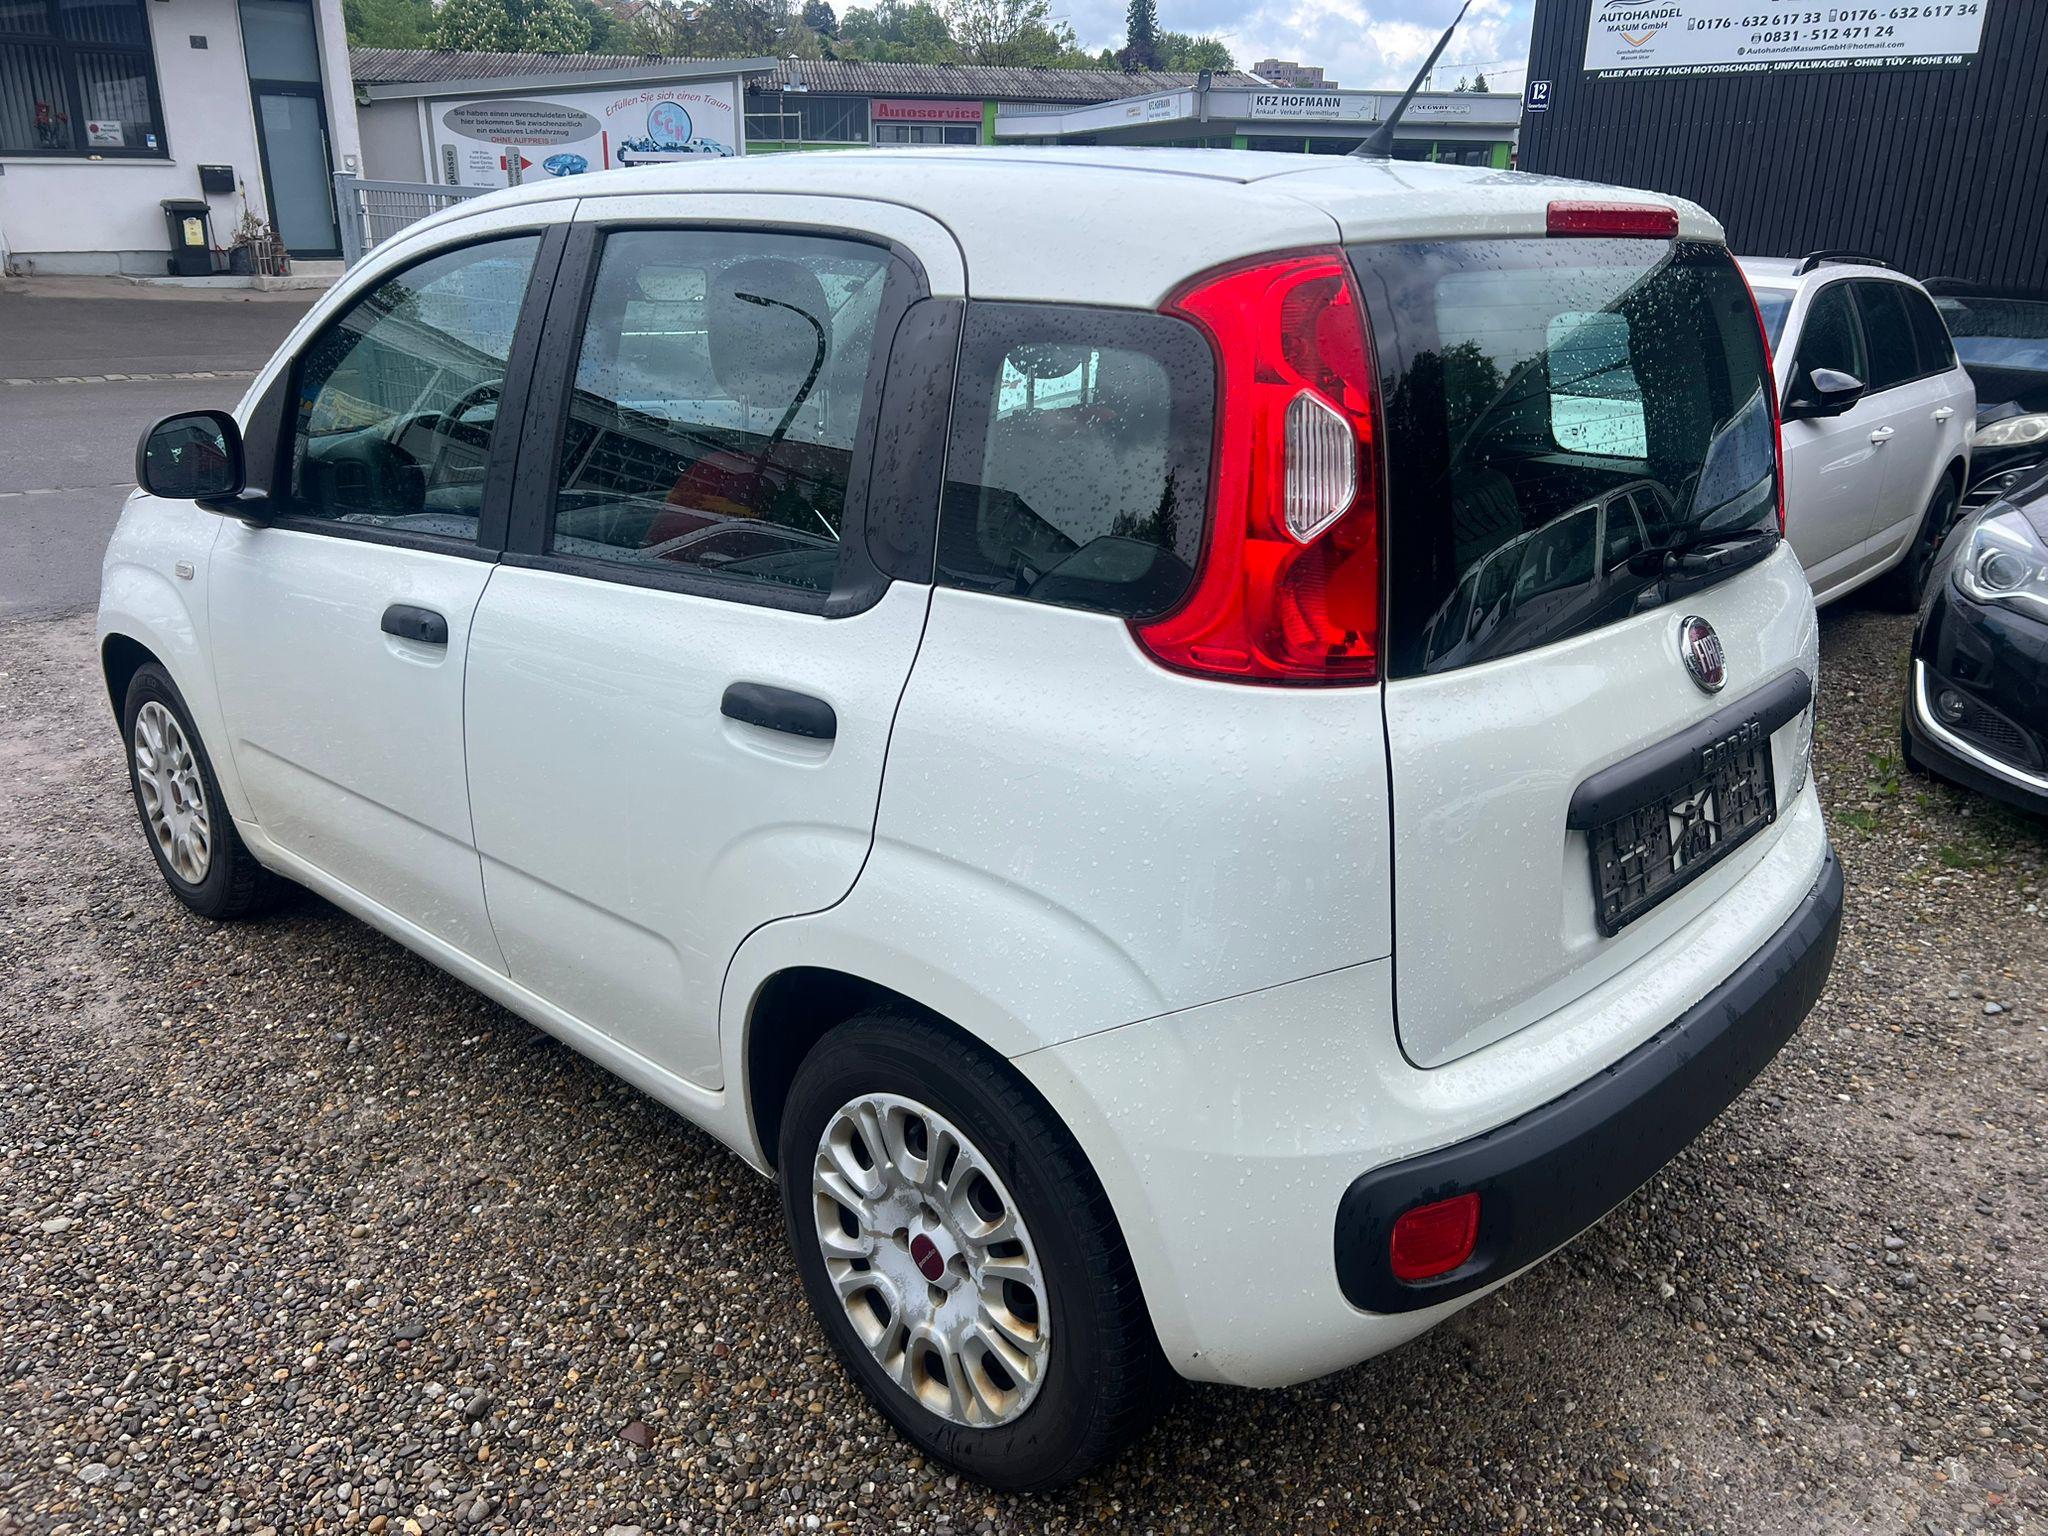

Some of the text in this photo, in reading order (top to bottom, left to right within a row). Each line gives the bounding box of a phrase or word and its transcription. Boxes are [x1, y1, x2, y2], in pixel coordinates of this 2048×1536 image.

[1598, 8, 1683, 23] AUTOHANDEL
[1839, 8, 1878, 22] 0176
[1889, 7, 1919, 19] 632
[1922, 5, 1954, 18] 617
[1957, 3, 1979, 16] 34
[1606, 21, 1669, 33] MASUM GmbH
[1697, 17, 1731, 31] 0176
[1742, 16, 1768, 28] 632
[1772, 13, 1800, 26] 617
[1803, 12, 1822, 24] 33
[1763, 30, 1799, 43] 0831
[1811, 28, 1838, 40] 512
[1842, 27, 1870, 39] 471
[1874, 25, 1895, 37] 24
[1746, 42, 1905, 55] AutohandelMasumGmbH@hotmail.com
[1598, 69, 1624, 79] ALLER
[1625, 68, 1643, 78] ART
[1643, 67, 1661, 76] KFZ
[1665, 66, 1692, 76] AUCH
[1692, 62, 1769, 74] MOTORSCHADEN
[1774, 60, 1849, 71] UNFALLWAGEN
[1854, 58, 1884, 67] OHNE
[1885, 56, 1907, 66] TÜV
[1913, 56, 1943, 66] HOHE
[1944, 55, 1963, 65] KM
[1532, 83, 1548, 100] 12
[605, 91, 732, 117] Erfüllen Sie sich einen Traum
[1256, 96, 1341, 107] KFZ HOFMANN
[510, 111, 566, 119] unverschuldeten
[878, 103, 981, 119] Autoservice
[527, 120, 583, 128] zwischenzeitlich
[525, 128, 570, 137] Leihfahrzeug
[513, 137, 550, 145] AUFPREIS
[1693, 634, 1722, 674] FIAT
